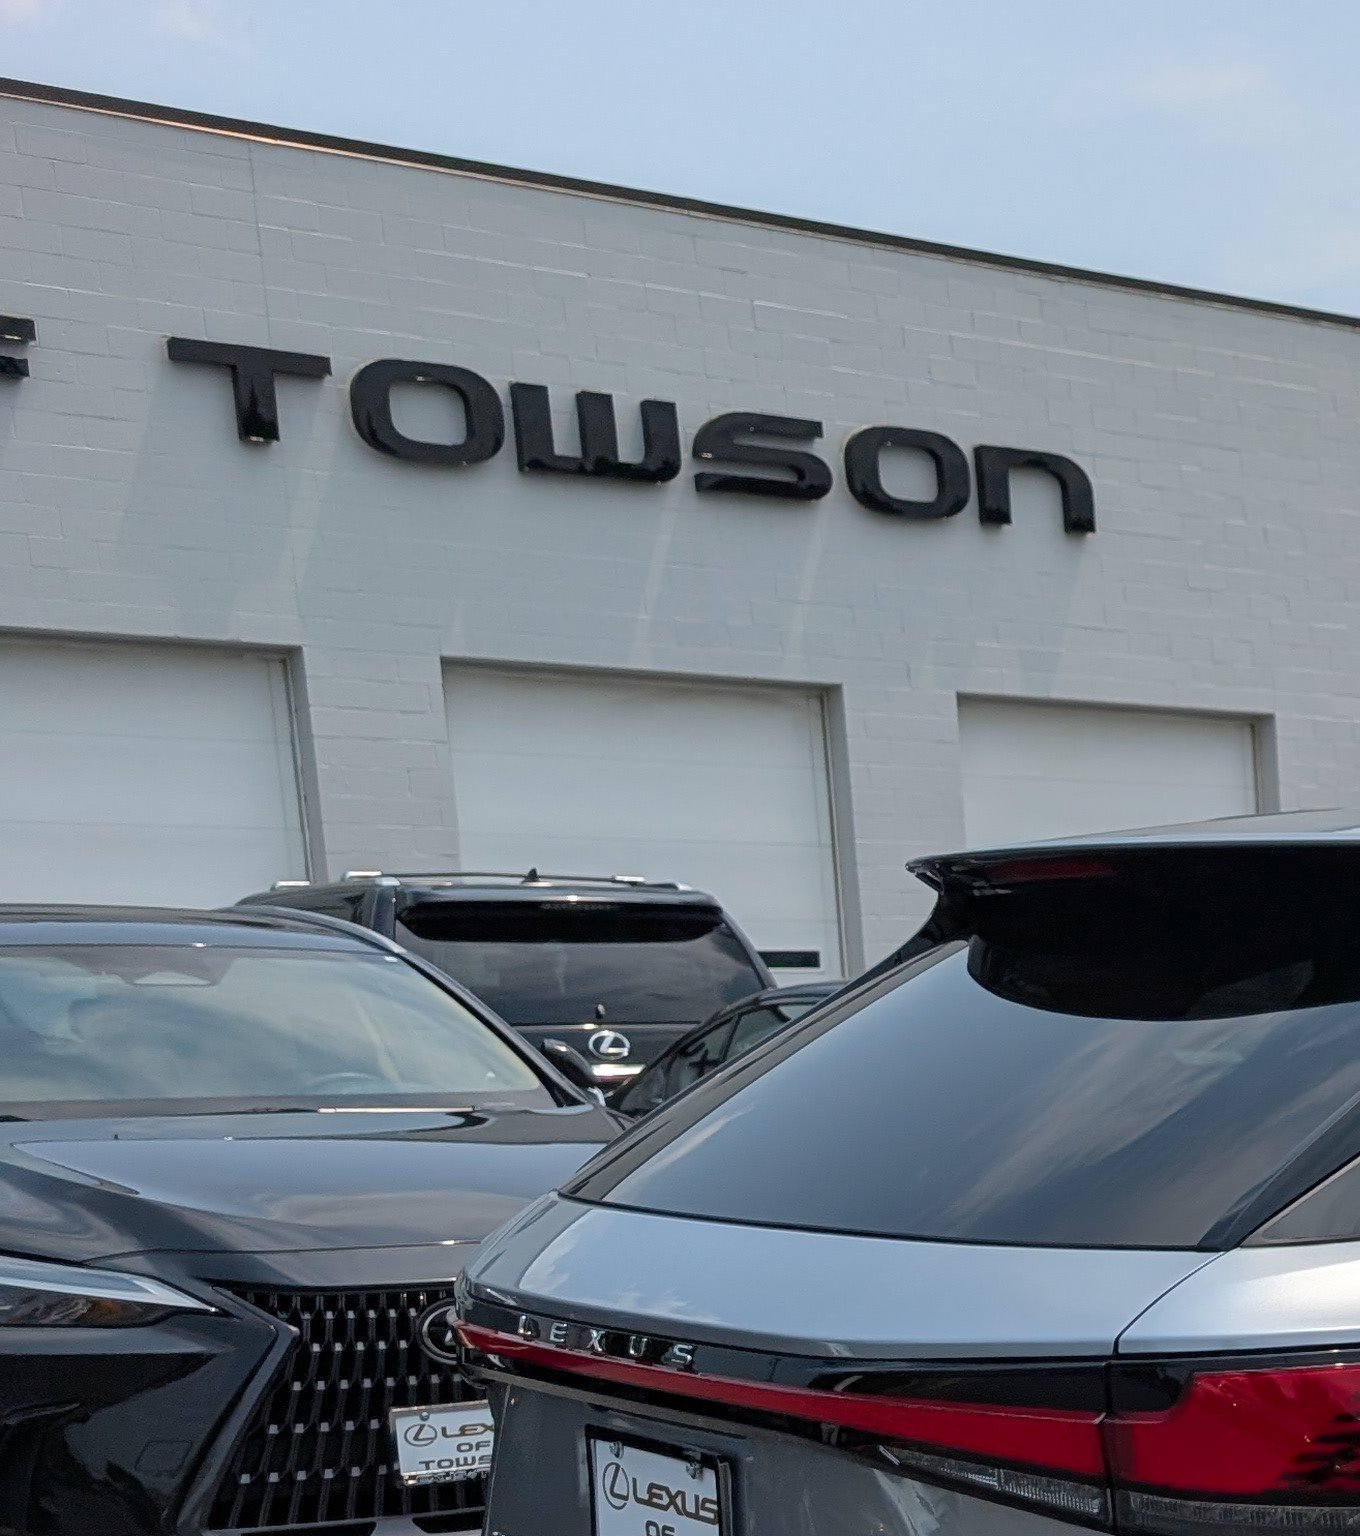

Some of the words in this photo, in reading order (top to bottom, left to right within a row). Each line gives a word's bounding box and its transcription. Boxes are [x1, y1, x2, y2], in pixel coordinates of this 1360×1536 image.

[166, 335, 1097, 536] TOWSON
[517, 1315, 693, 1364] LEXUS
[441, 1422, 495, 1439] LEX
[456, 1440, 491, 1453] OF
[418, 1454, 492, 1471] TOWS
[632, 1476, 719, 1526] LEXUS
